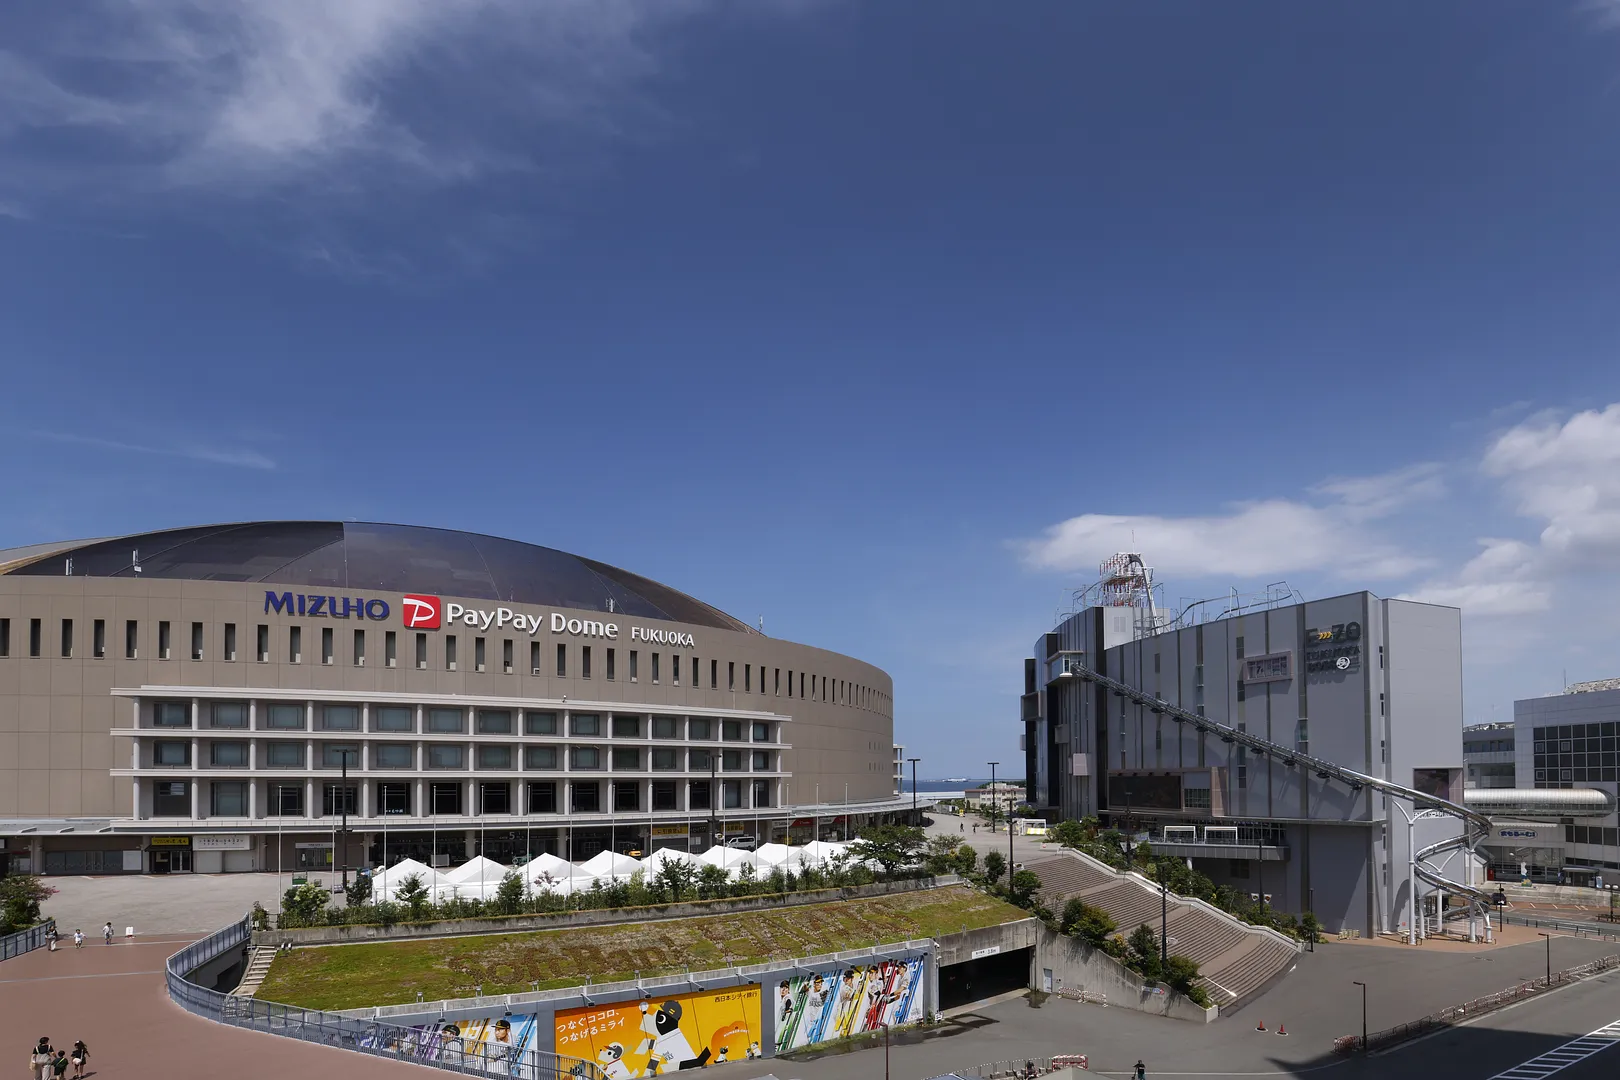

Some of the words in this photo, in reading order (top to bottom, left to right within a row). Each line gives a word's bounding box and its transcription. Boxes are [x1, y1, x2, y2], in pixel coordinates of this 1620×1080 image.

[264, 591, 390, 620] MIZUHO
[446, 603, 543, 634] PayPay
[551, 612, 618, 638] Dome
[631, 627, 695, 647] FUKUOKA
[714, 992, 758, 1003] 西日本シティ銀行
[556, 1009, 620, 1033] つなぐココロ、
[559, 1017, 625, 1045] つなげるミライ
